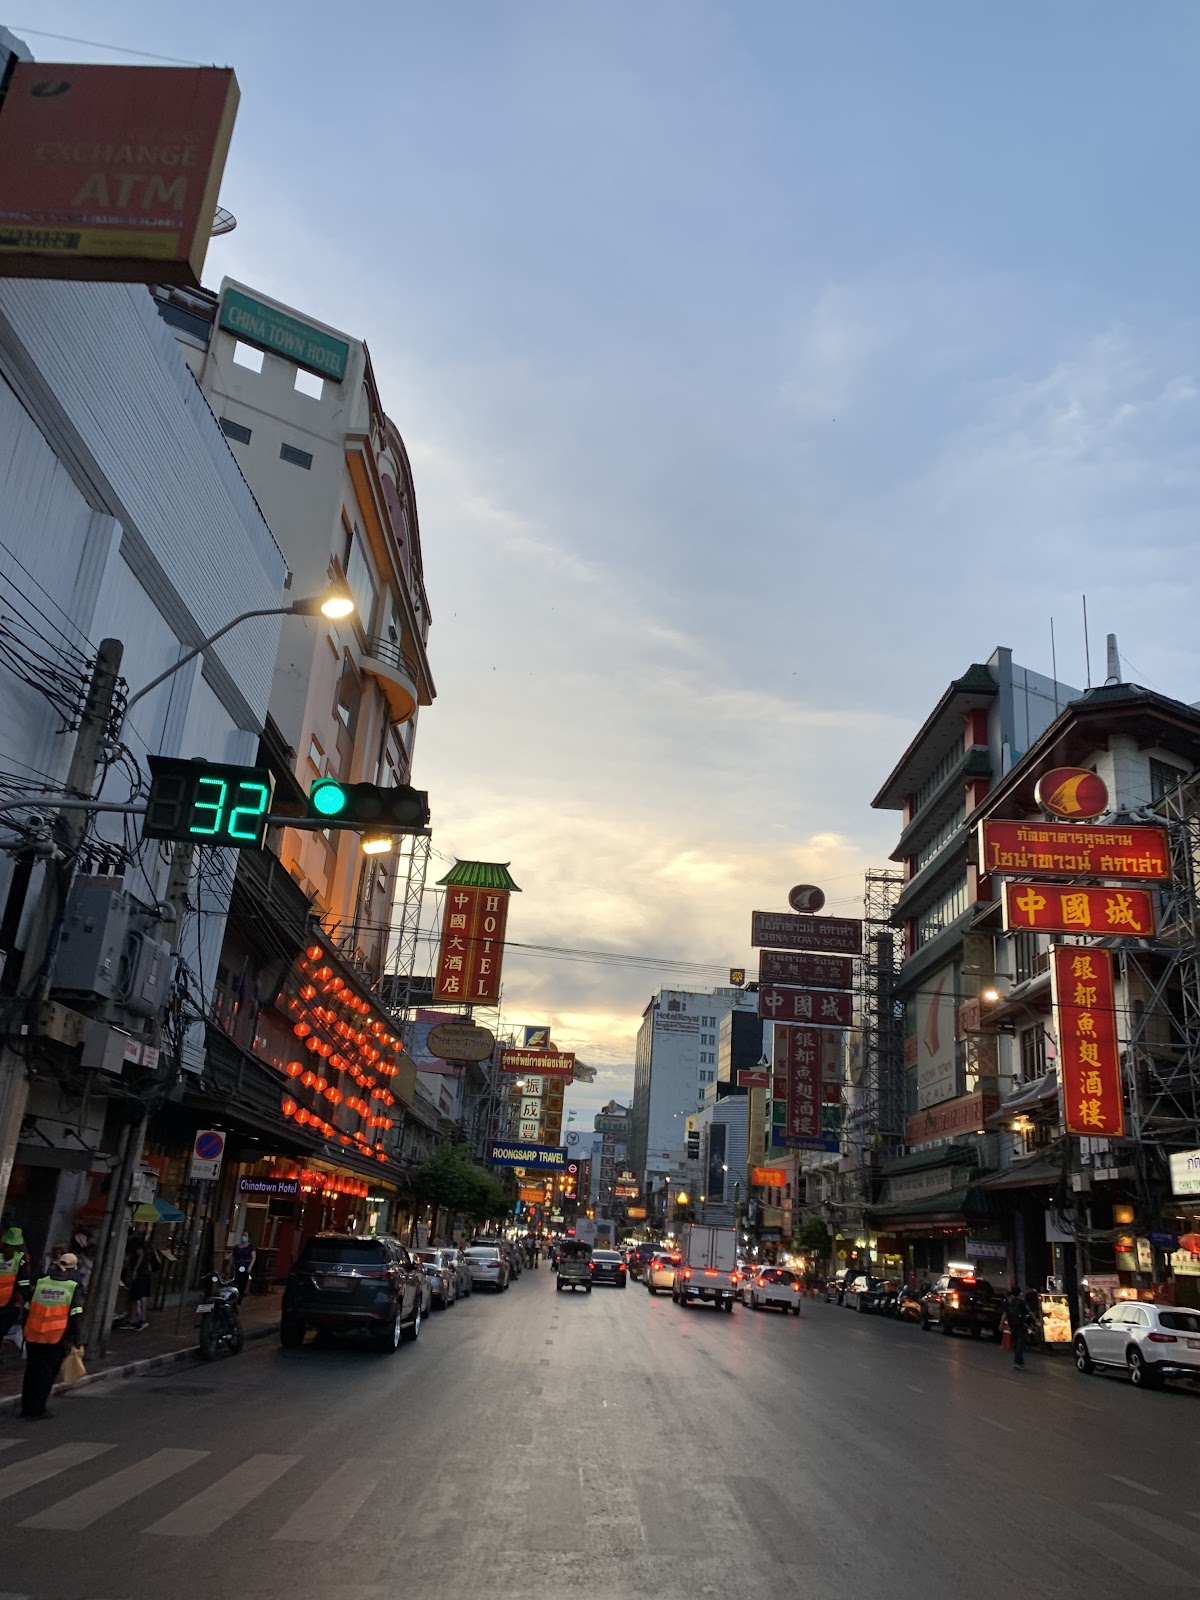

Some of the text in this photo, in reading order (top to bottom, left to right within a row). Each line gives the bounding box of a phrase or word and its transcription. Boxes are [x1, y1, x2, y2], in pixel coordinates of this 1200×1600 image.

[34, 142, 196, 166] EXCHANGE
[72, 172, 188, 211] ATM
[228, 306, 265, 337] CHINA
[269, 324, 305, 355] TOWN
[307, 341, 341, 371] HOTEL
[190, 778, 268, 840] 32
[1016, 825, 1133, 848] ภัตตาคารหูฉลาม
[991, 842, 1163, 874] ไชน่าทาวน์ สกาล่า
[1016, 887, 1142, 932] 中國城
[441, 892, 470, 993] 中國大酒店
[477, 895, 500, 996] HOTEL
[759, 932, 855, 948] CHINA TOWN SCALA
[764, 990, 843, 1022] 中國城
[431, 1036, 492, 1048] CHINA TOWN
[1071, 955, 1107, 1129] 銀都魚翅酒樓
[792, 1031, 816, 1135] 銀都魚翅酒樓
[493, 1148, 564, 1164] ROONGSARP TRAVEL
[241, 1179, 298, 1193] Chinatown Hotel
